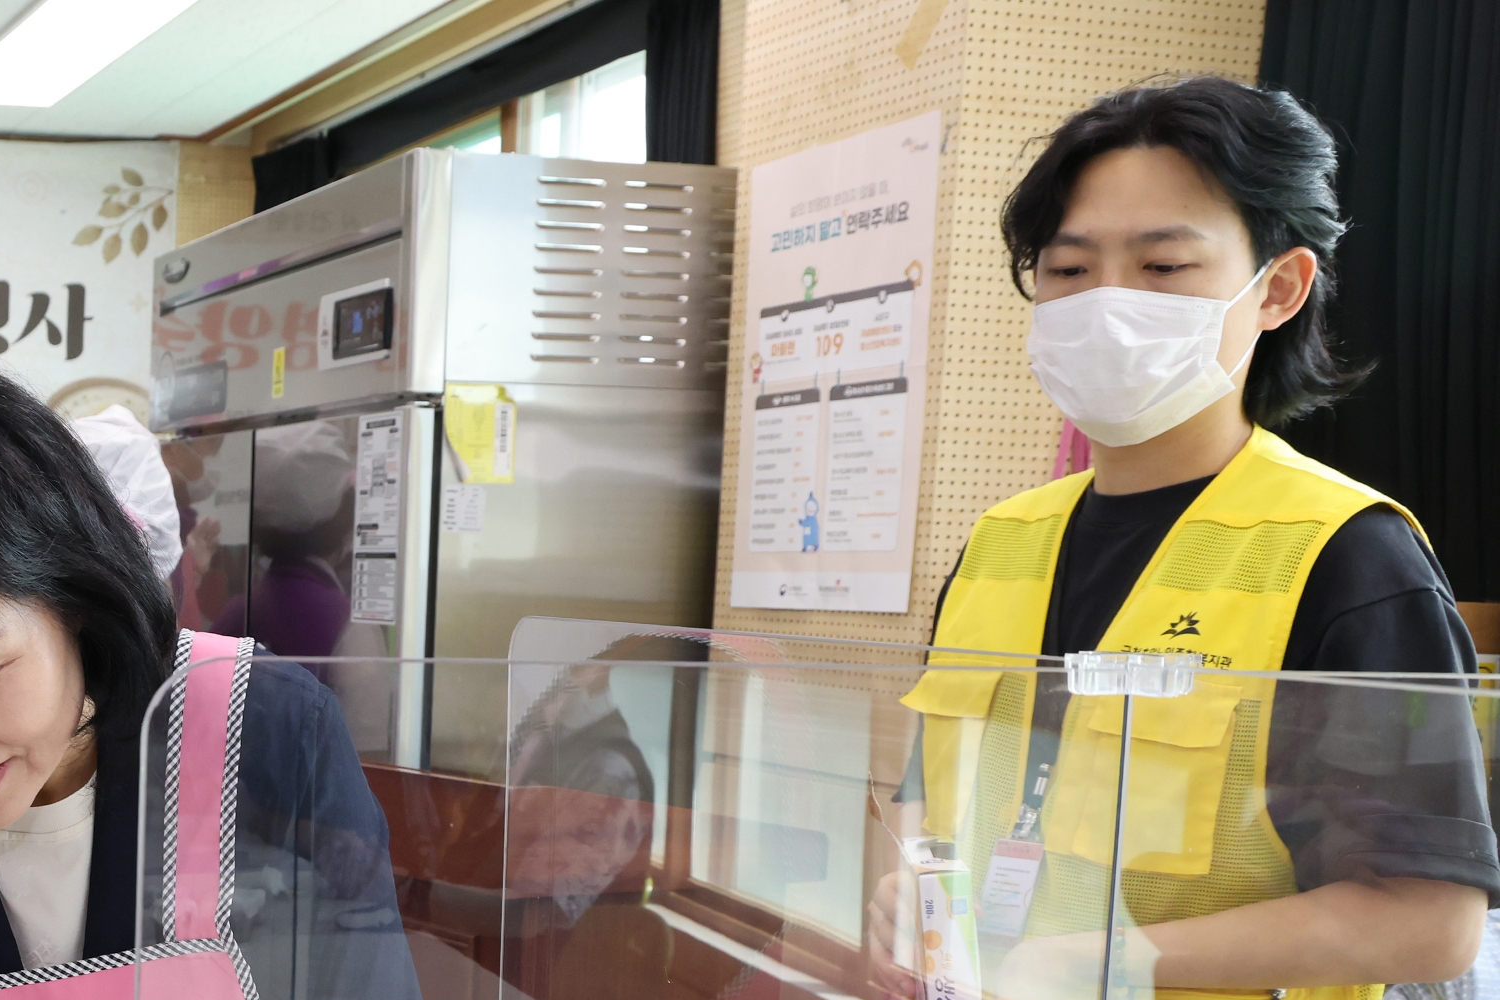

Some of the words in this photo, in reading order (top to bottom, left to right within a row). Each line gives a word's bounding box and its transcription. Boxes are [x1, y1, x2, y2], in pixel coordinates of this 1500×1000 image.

[771, 223, 816, 252] 고민하지
[819, 217, 842, 241] 말고
[846, 201, 909, 235] 연락주세요
[816, 332, 844, 357] 109
